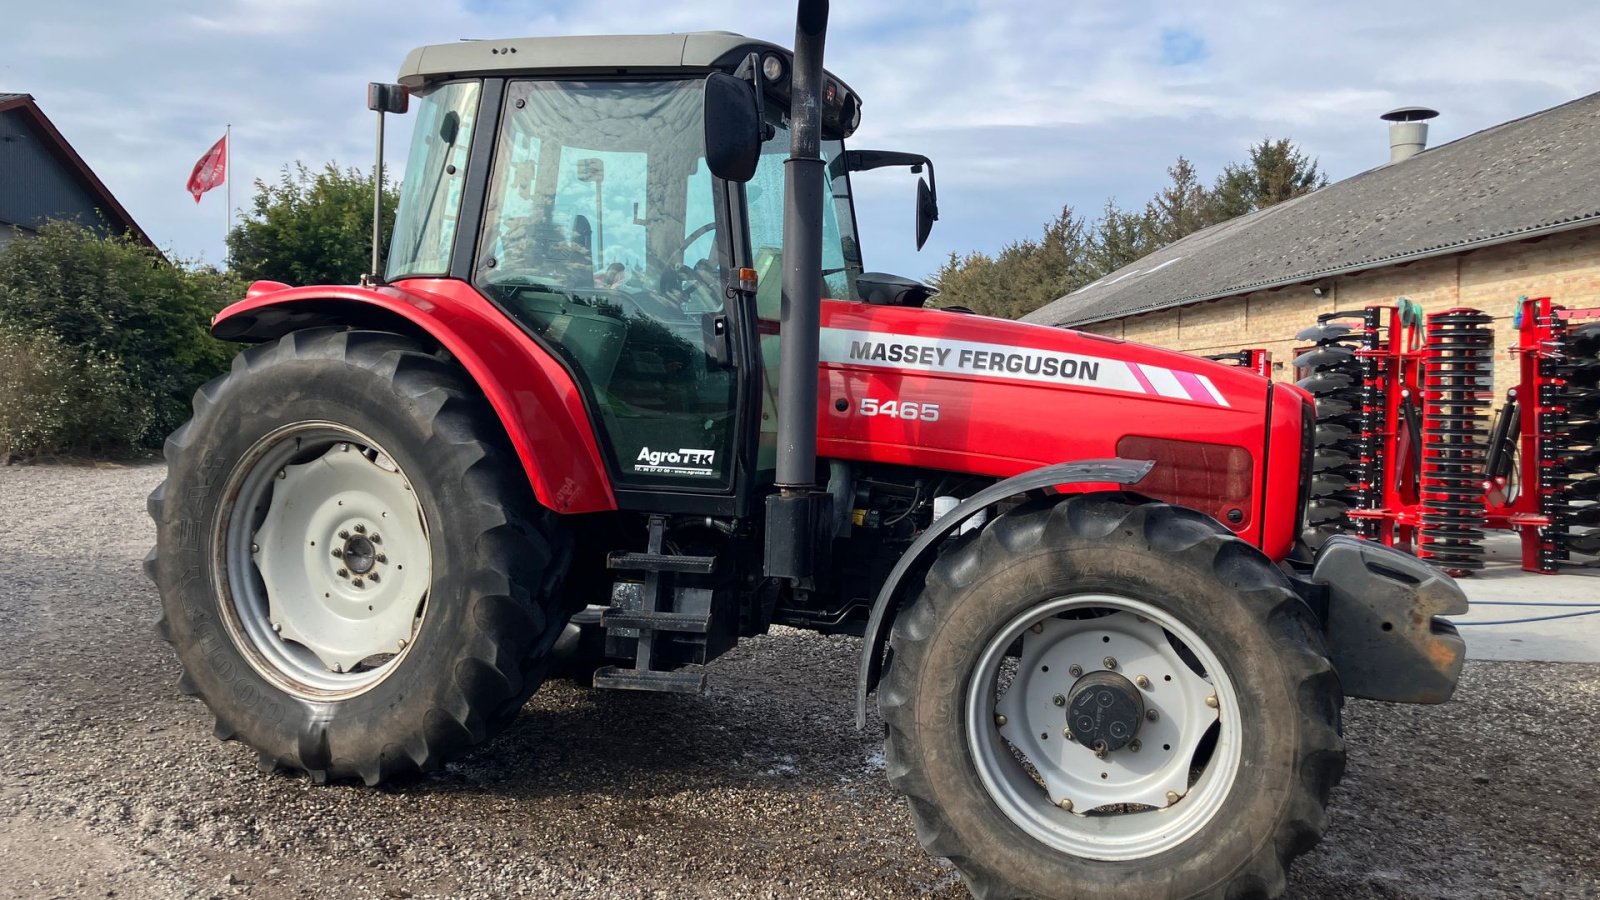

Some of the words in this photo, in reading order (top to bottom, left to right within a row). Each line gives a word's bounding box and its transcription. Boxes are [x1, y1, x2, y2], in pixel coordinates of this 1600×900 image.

[849, 340, 951, 366] MASSEY
[958, 349, 1100, 381] FERGUSON
[859, 398, 941, 422] 5465
[637, 446, 715, 466] AgroTEK
